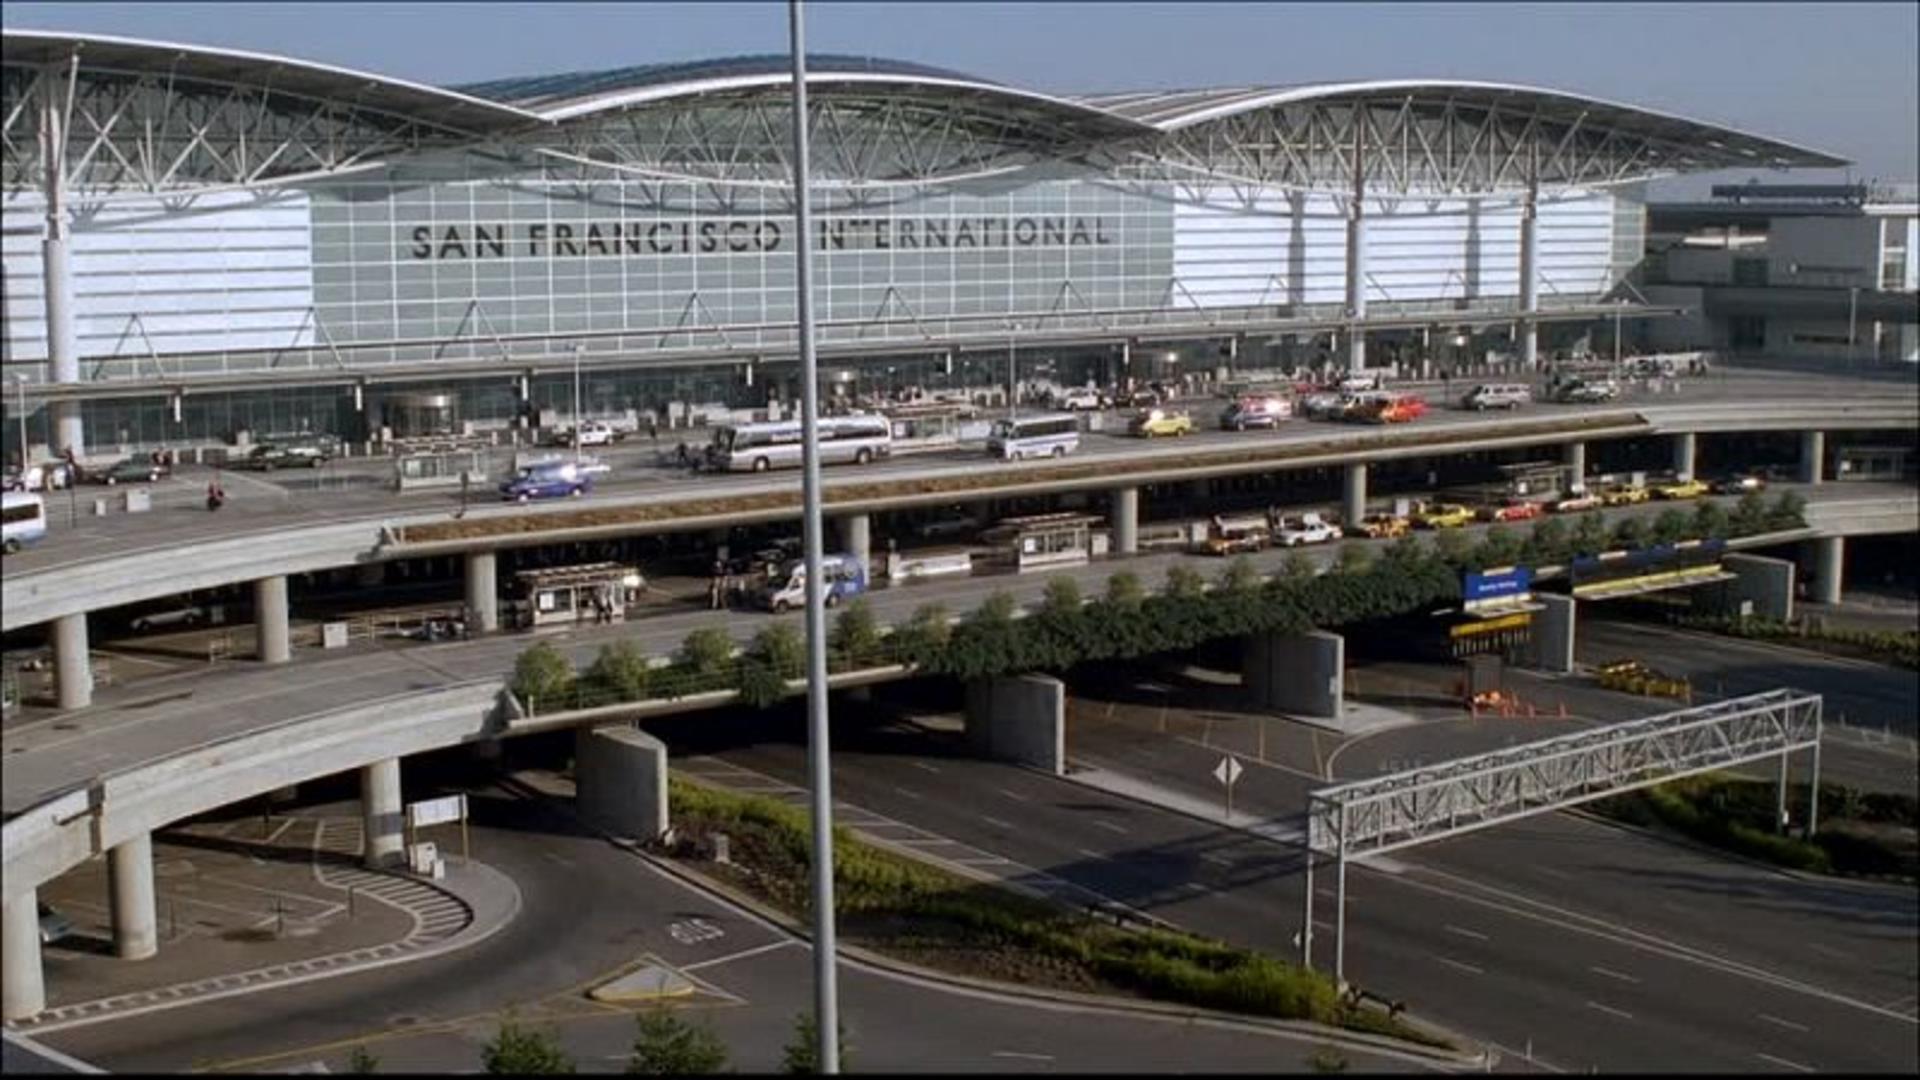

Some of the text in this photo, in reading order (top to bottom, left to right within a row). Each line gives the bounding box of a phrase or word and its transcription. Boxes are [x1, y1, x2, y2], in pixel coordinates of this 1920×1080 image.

[412, 217, 1110, 259] SAN FRANCISCO NTERNATIONAL
